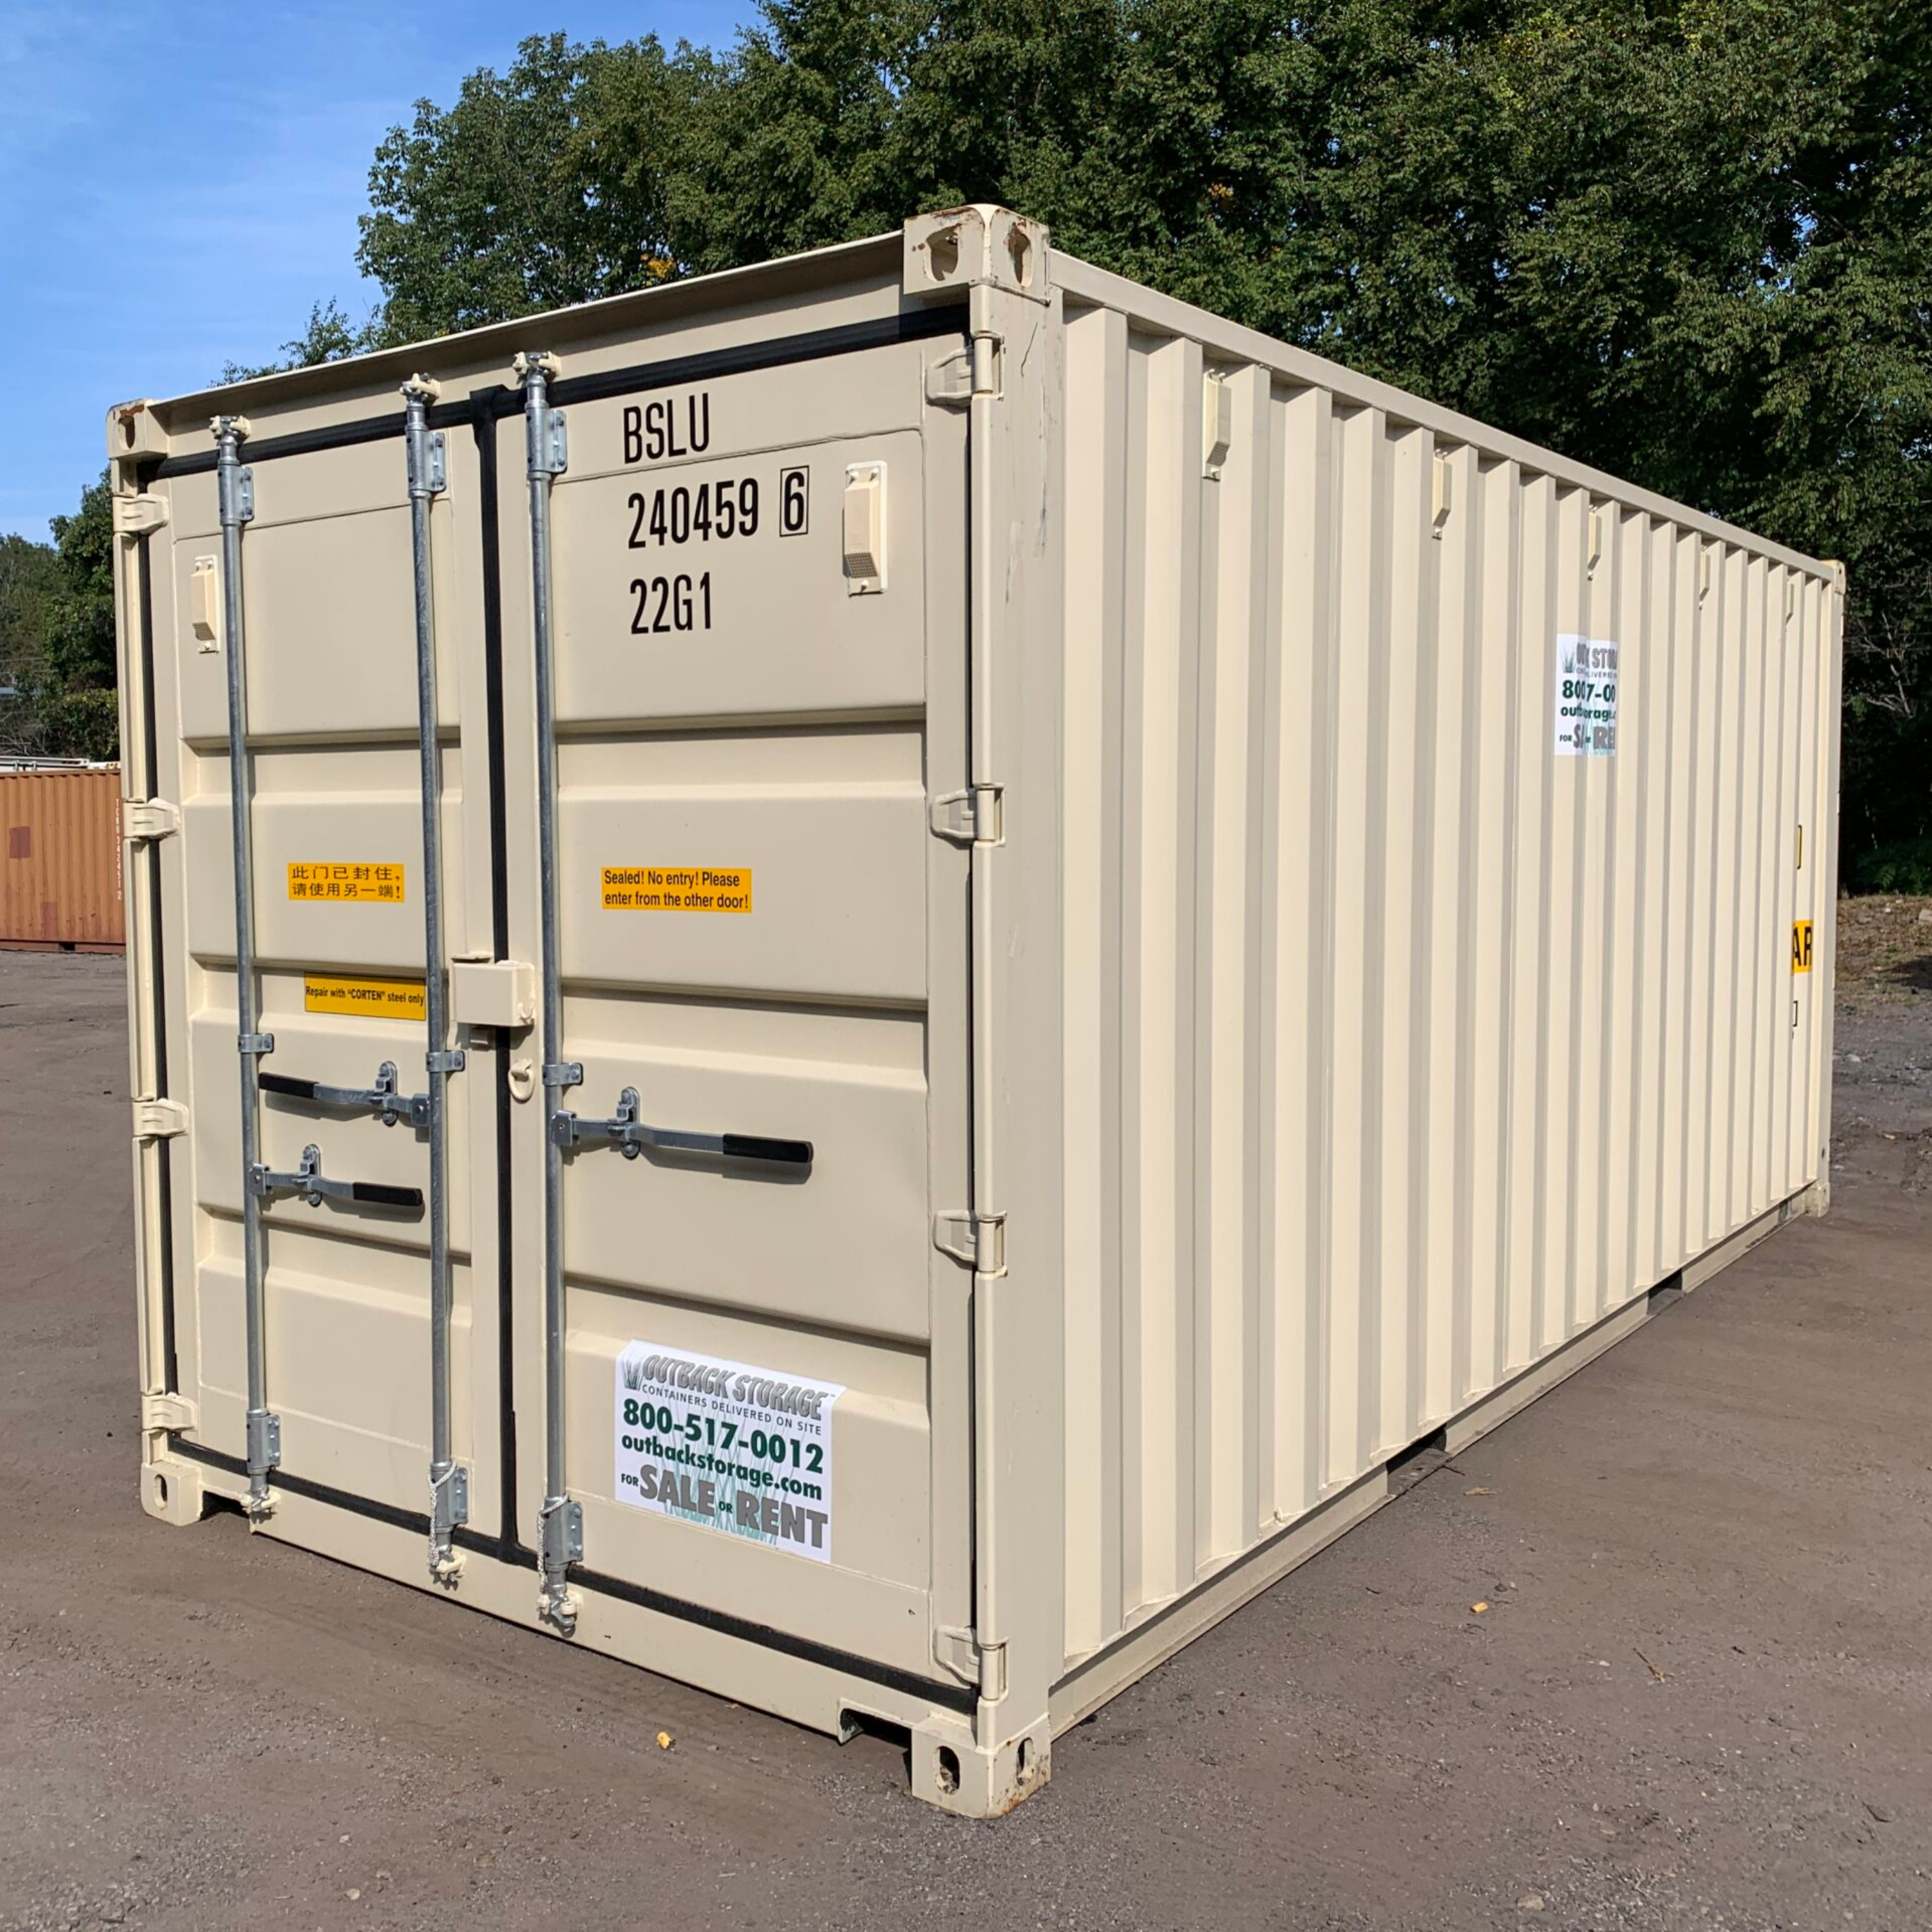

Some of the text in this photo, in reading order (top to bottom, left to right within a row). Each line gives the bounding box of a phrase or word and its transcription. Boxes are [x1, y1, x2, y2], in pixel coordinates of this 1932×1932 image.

[623, 392, 710, 464] BSLU
[627, 471, 806, 549] 240459 6
[629, 572, 711, 634] 22G1
[605, 870, 740, 889] Sealed! No entry! Please
[605, 891, 748, 909] enter from the other door!
[306, 986, 328, 997] Repair
[330, 987, 346, 998] with
[387, 992, 406, 1003] steel
[408, 994, 424, 1006] only
[641, 1384, 822, 1435] CONTAINERS DELIVERED ON SITE
[644, 1354, 829, 1421] OUTBACK STORAGE
[621, 1434, 822, 1500] outbackstorage.com
[623, 1398, 823, 1474] 800-517-0012
[621, 1464, 828, 1548] FOR SALE OR RENT
